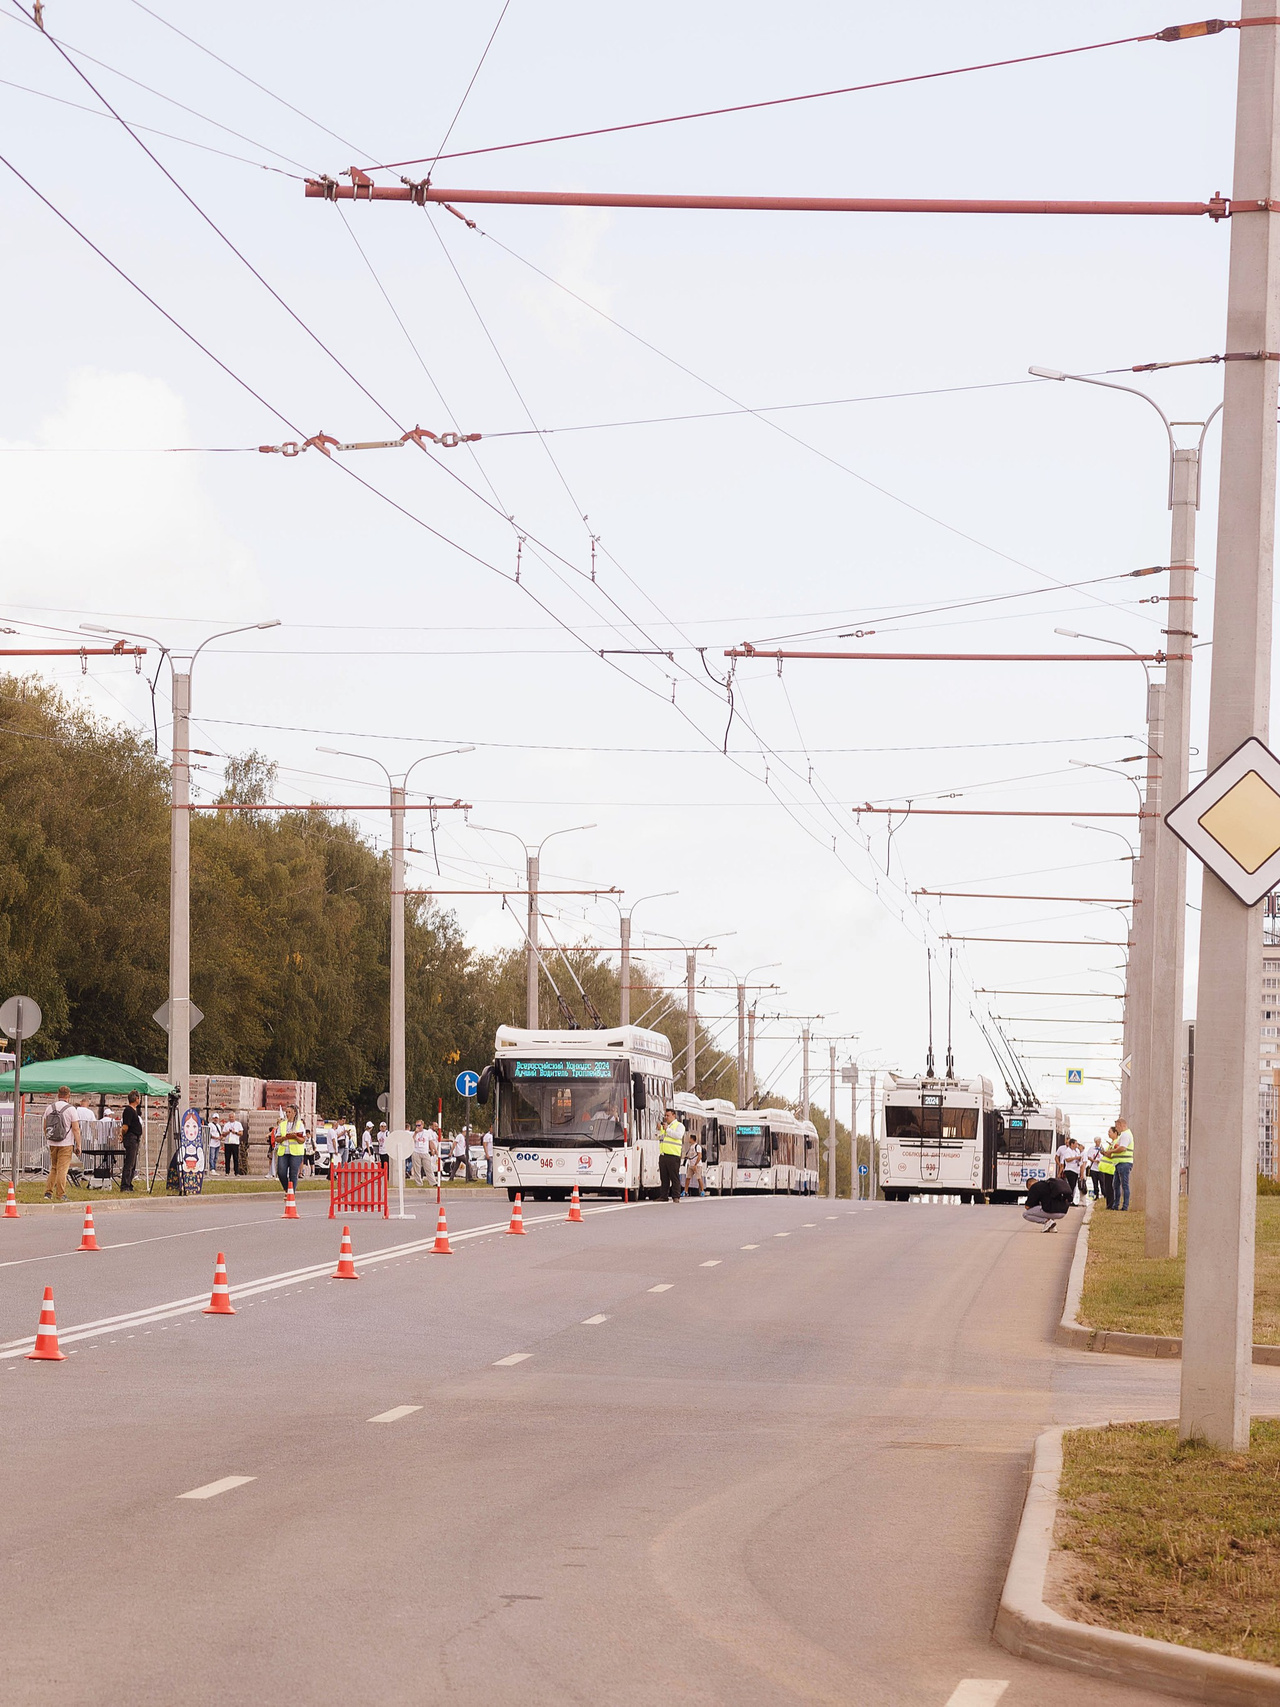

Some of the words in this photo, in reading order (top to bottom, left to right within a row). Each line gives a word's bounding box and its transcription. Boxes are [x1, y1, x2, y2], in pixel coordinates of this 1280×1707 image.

[566, 1061, 591, 1070] Конкурс
[594, 1061, 610, 1070] 2024
[539, 1069, 569, 1078] Водитель
[572, 1069, 612, 1078] Троллейбуса
[540, 1158, 554, 1168] 946
[1020, 1168, 1046, 1178] 555
